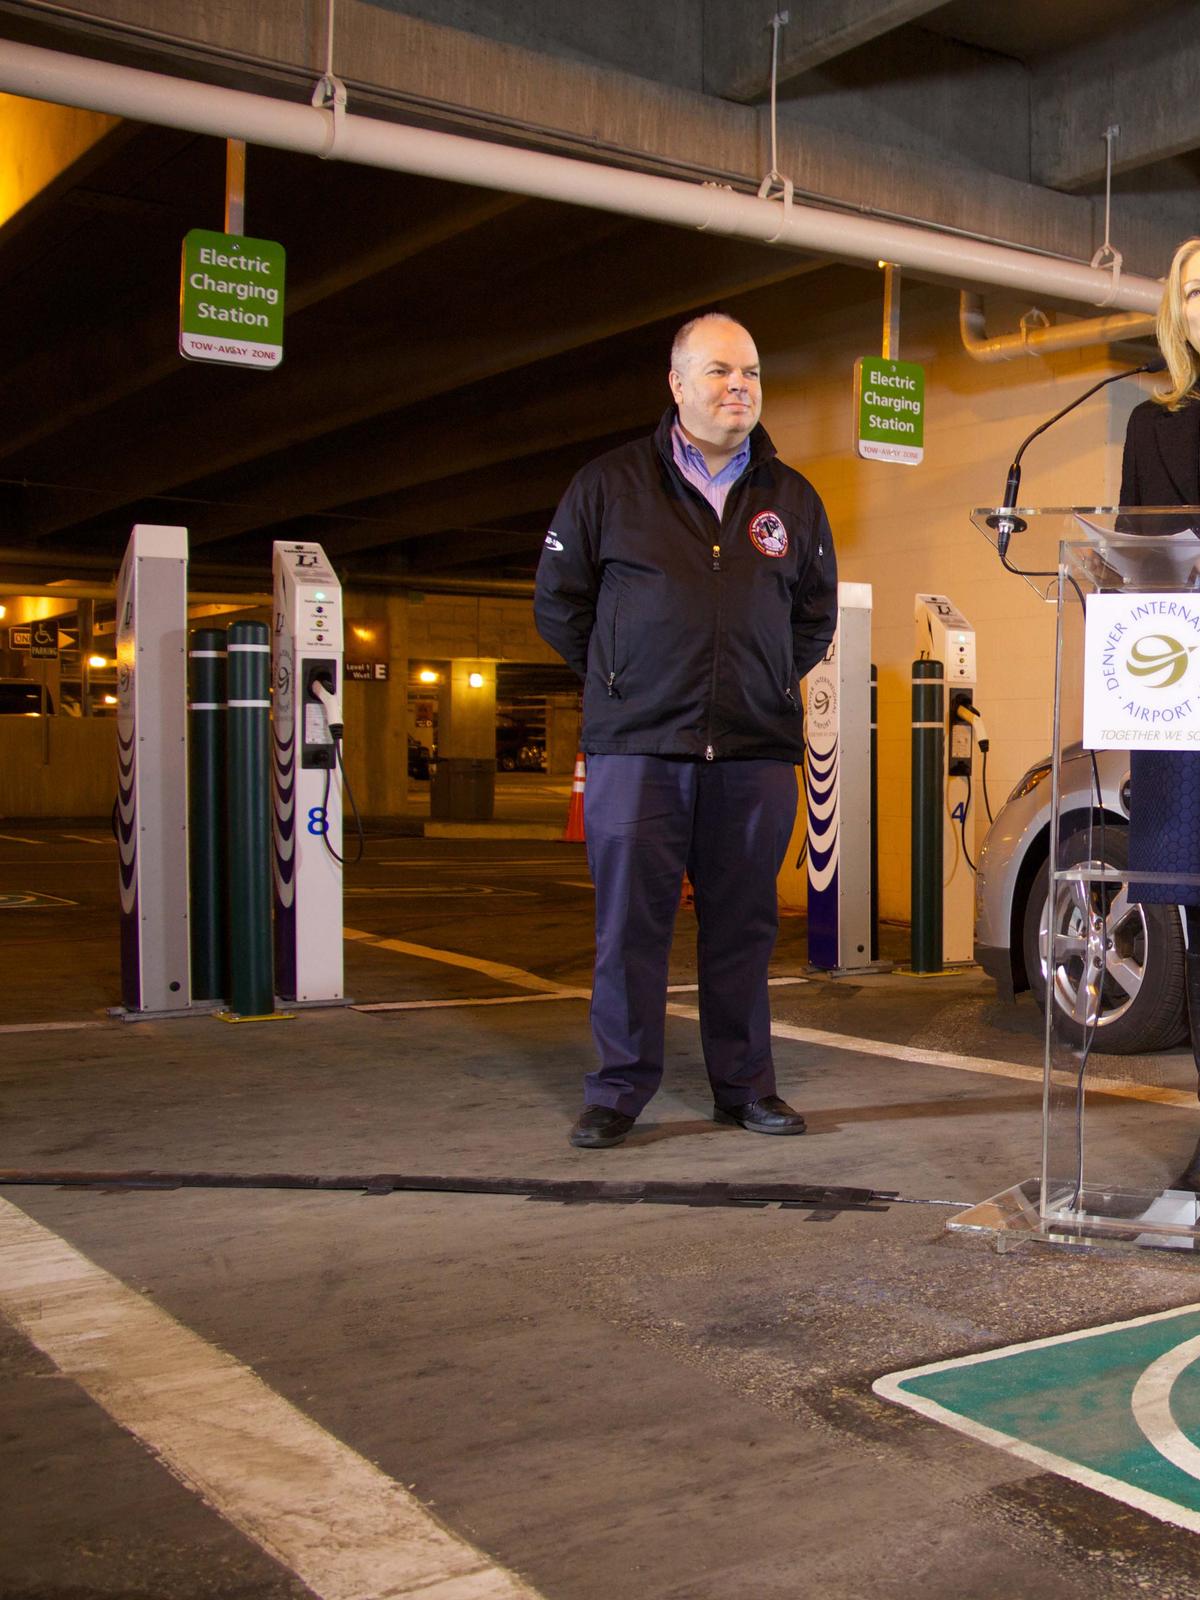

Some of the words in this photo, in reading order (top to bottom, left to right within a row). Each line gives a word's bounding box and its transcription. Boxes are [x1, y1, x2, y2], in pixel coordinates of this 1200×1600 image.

[200, 248, 271, 274] Electric
[190, 273, 278, 305] Charging
[198, 302, 269, 328] Station
[252, 350, 276, 360] ZONE
[870, 371, 916, 391] Electric
[864, 391, 921, 415] Charging
[869, 414, 915, 433] Station
[346, 663, 365, 671] Level
[1102, 622, 1128, 691] DENVER
[375, 663, 387, 680] E
[1122, 699, 1193, 723] AIRPORT
[1100, 729, 1161, 741] TOGETHER
[1164, 730, 1183, 741] WE
[307, 806, 329, 836] 8
[951, 802, 965, 824] 4
